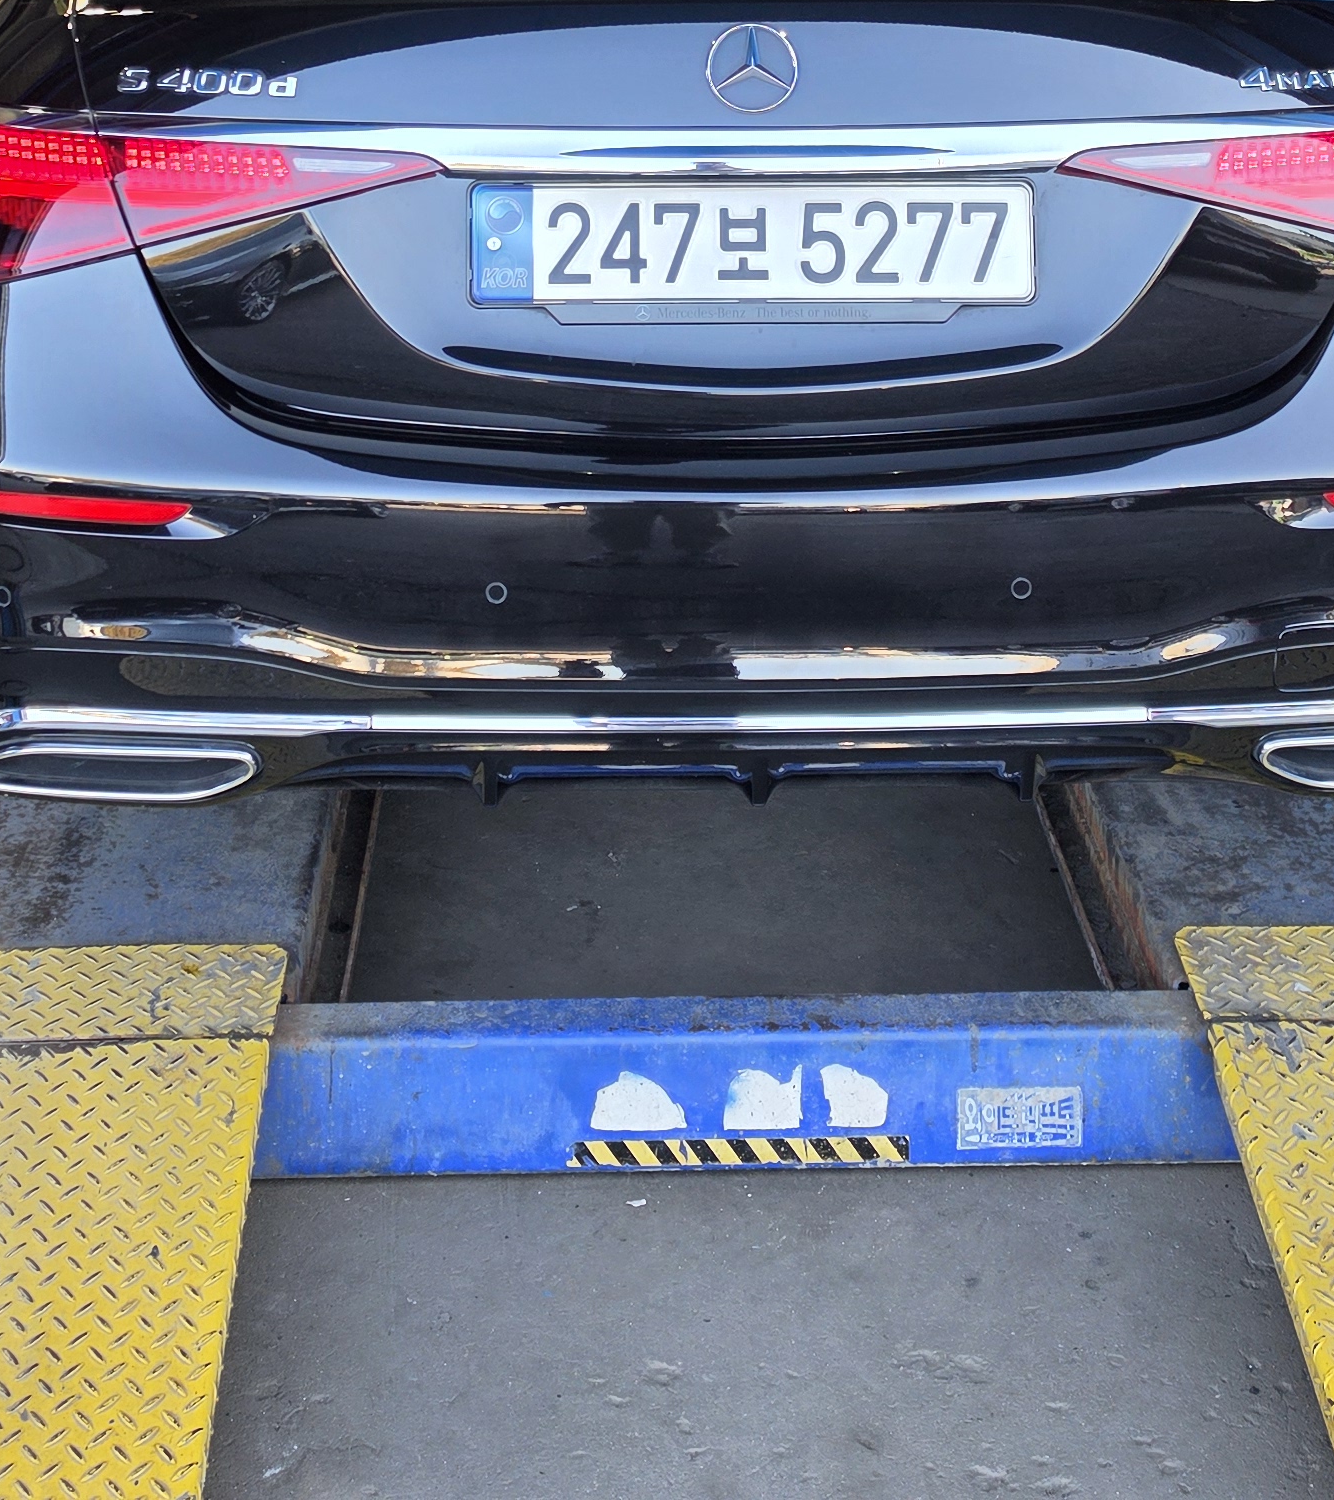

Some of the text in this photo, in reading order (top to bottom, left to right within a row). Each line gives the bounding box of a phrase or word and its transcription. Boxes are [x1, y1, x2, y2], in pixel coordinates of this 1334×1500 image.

[547, 202, 1009, 285] 247보 5277
[480, 266, 527, 289] KOR
[657, 306, 873, 321] Mercedes-Benz The best or nothing.
